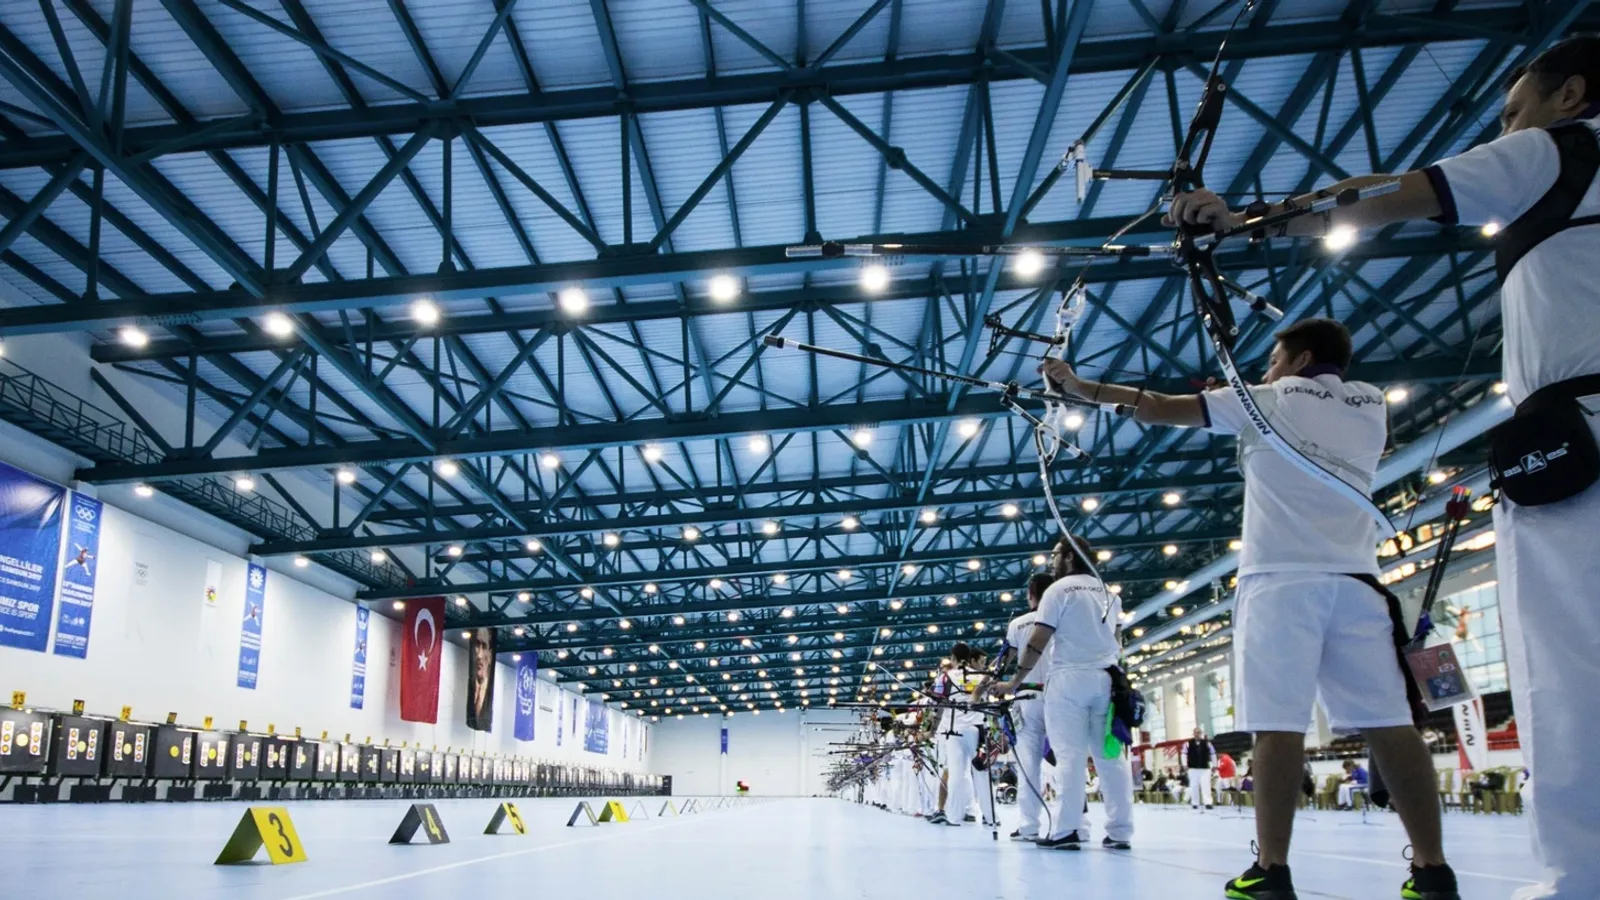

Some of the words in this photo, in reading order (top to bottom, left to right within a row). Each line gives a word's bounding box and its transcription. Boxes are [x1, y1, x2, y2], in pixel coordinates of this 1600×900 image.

[1230, 375, 1271, 435] WIN&WIN
[268, 812, 293, 858] 3
[425, 807, 442, 840] 4
[507, 802, 525, 834] 5
